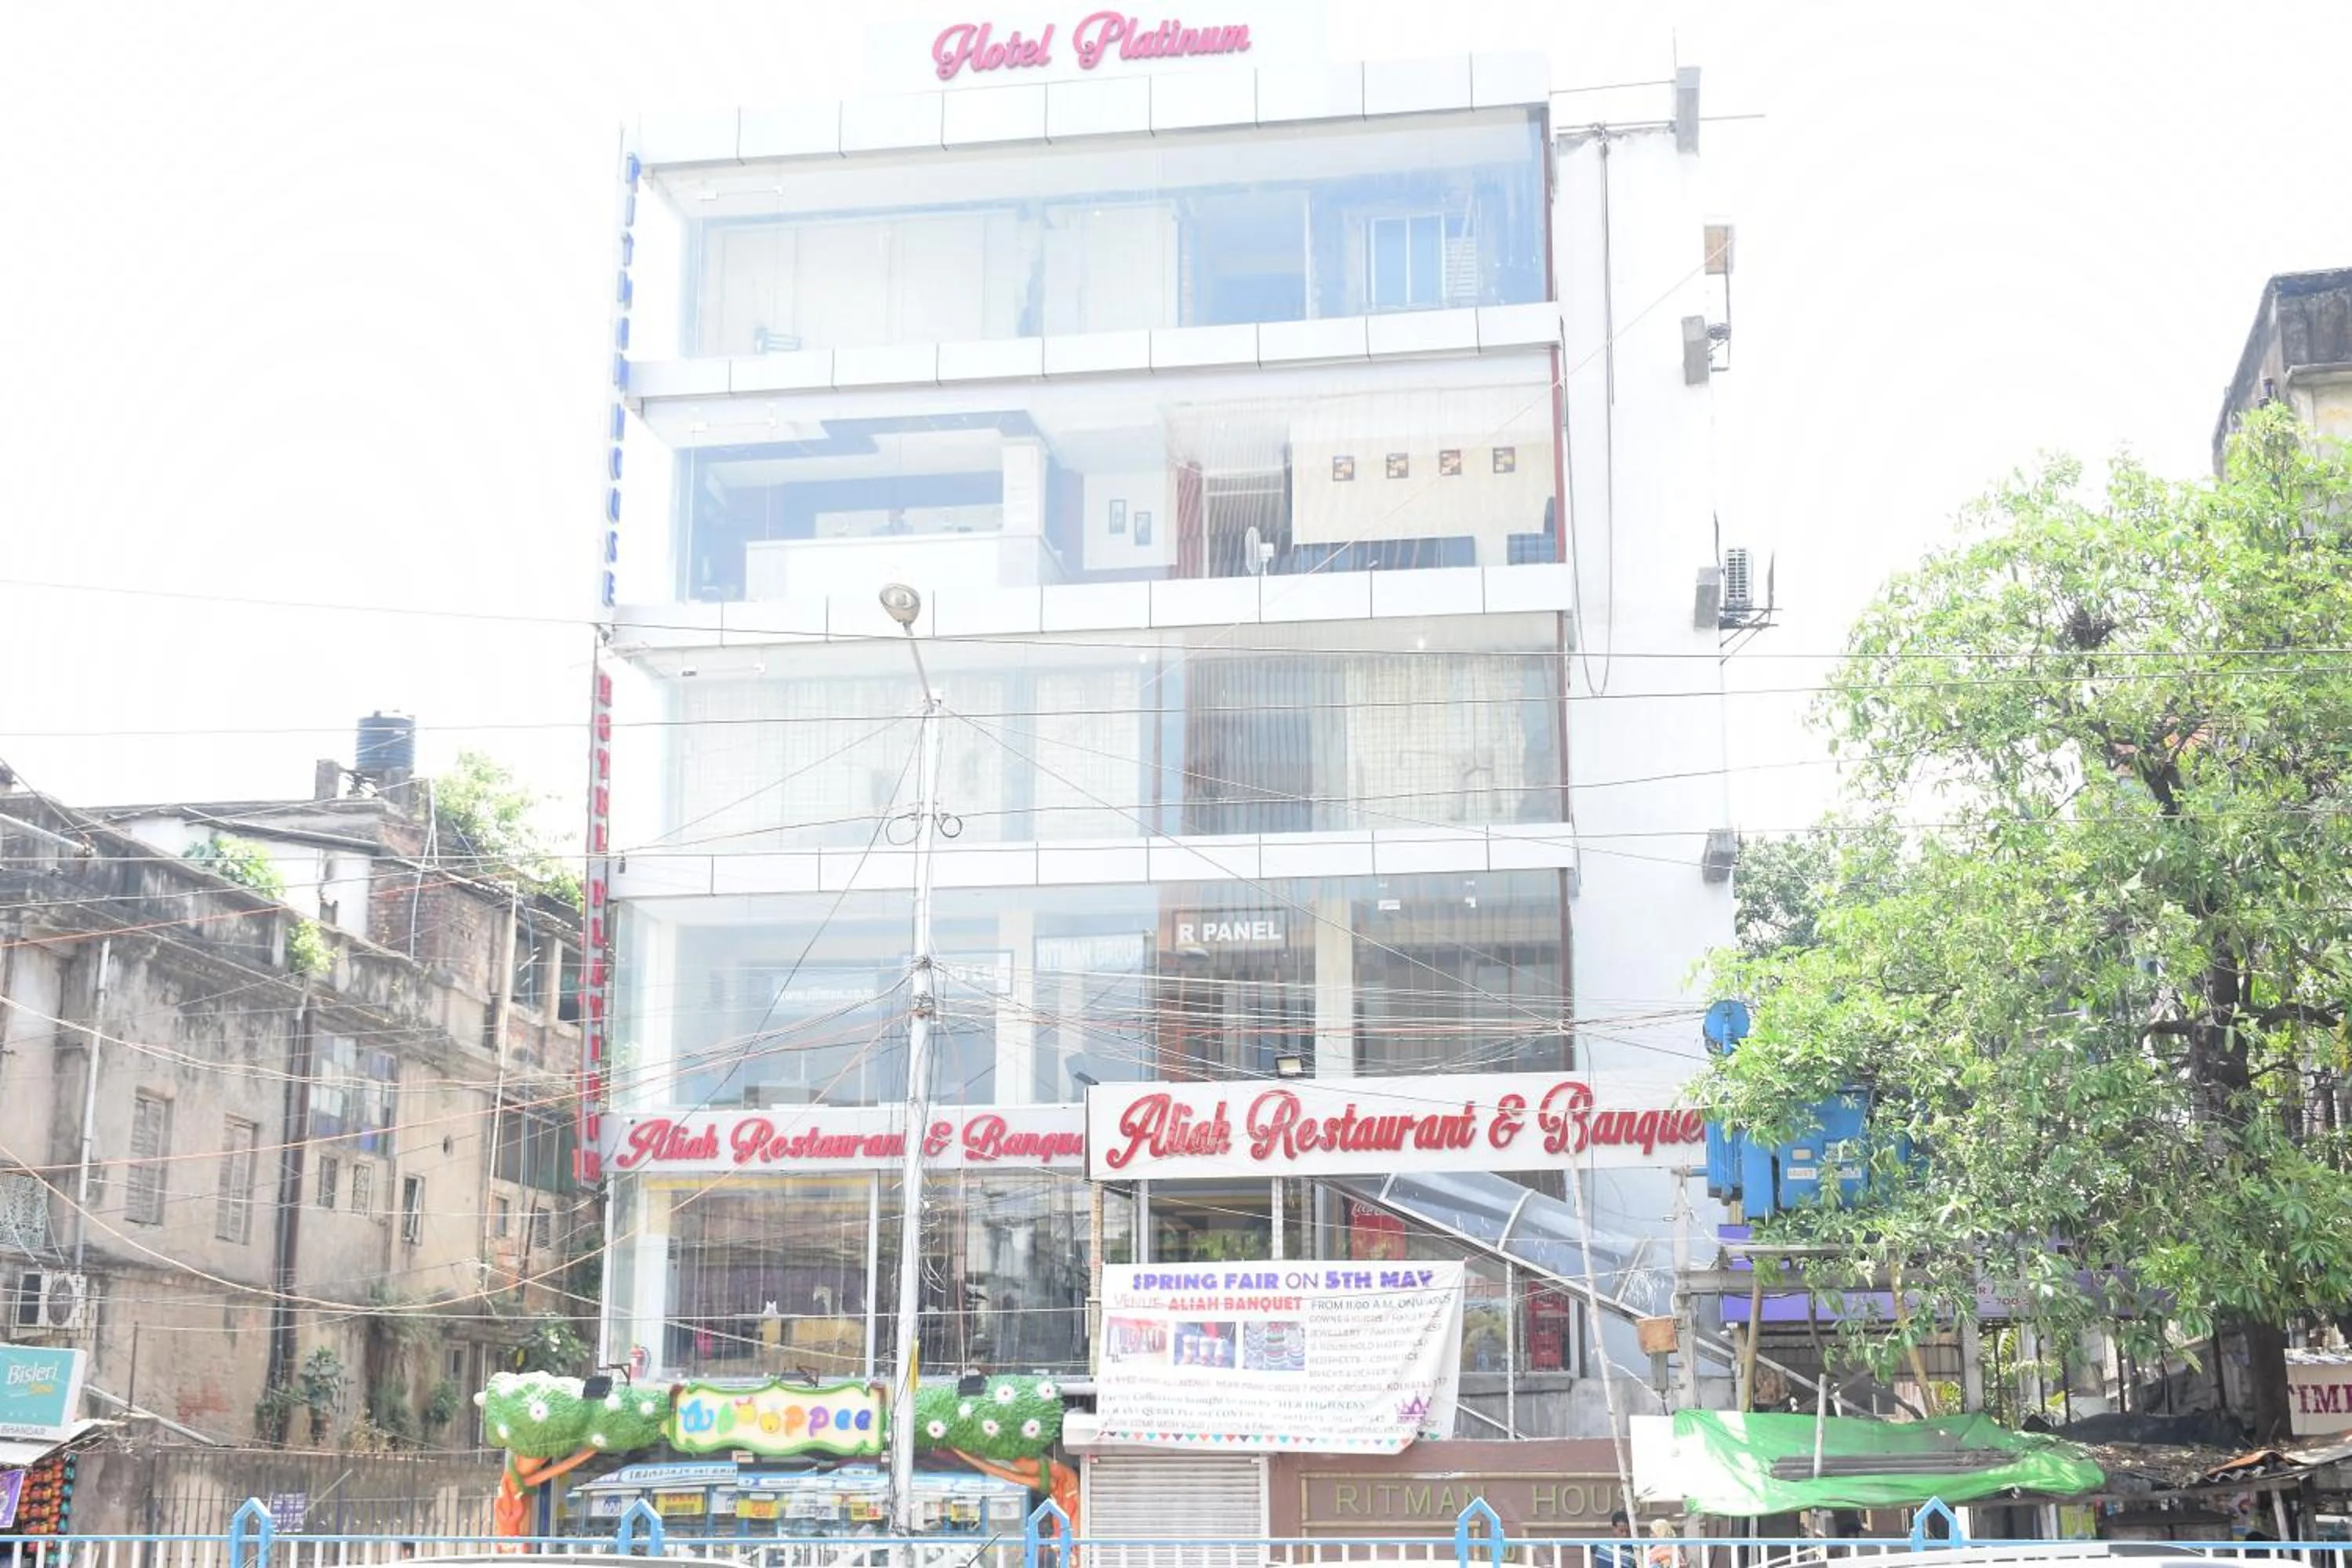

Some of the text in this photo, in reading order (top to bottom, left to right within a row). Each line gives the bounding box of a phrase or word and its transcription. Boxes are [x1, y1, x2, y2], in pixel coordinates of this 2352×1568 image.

[932, 10, 1252, 82] Hotel Platinum
[1203, 920, 1282, 942] PANEL
[1105, 1080, 1707, 1171] Aliah Restaurant & Banque
[615, 1118, 720, 1168] Aliah
[922, 1120, 952, 1158] &
[1132, 1269, 1433, 1291] SPRING FAIR ON 5TH MAY
[1167, 1295, 1219, 1312] ALIAH
[1223, 1295, 1303, 1314] BANQUET
[1310, 1299, 1343, 1312] FROM
[6, 1362, 59, 1385] Bisleri
[2287, 1384, 2352, 1414] IM
